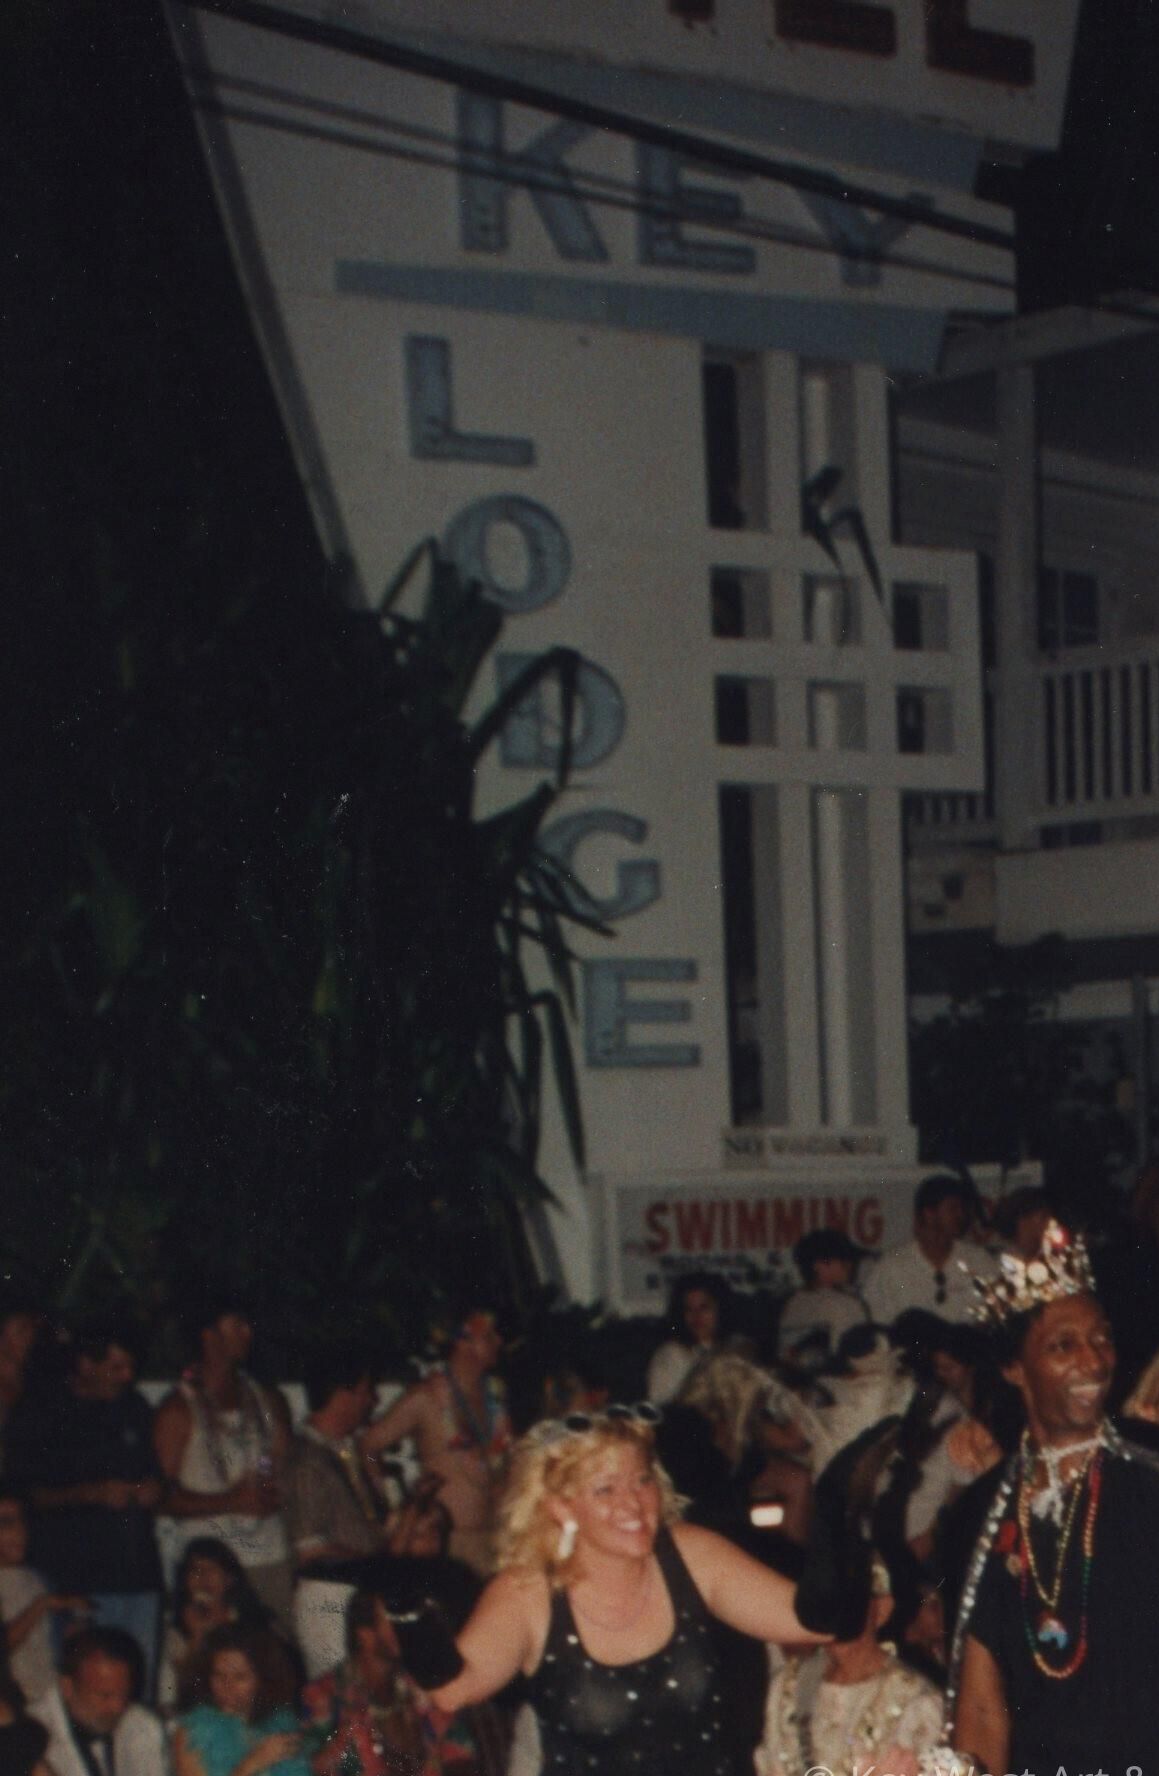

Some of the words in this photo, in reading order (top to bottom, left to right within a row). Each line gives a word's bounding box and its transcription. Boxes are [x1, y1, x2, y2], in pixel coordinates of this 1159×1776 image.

[456, 84, 936, 287] KEY
[405, 333, 701, 1069] LODGE
[645, 1196, 885, 1252] SWIMMING
